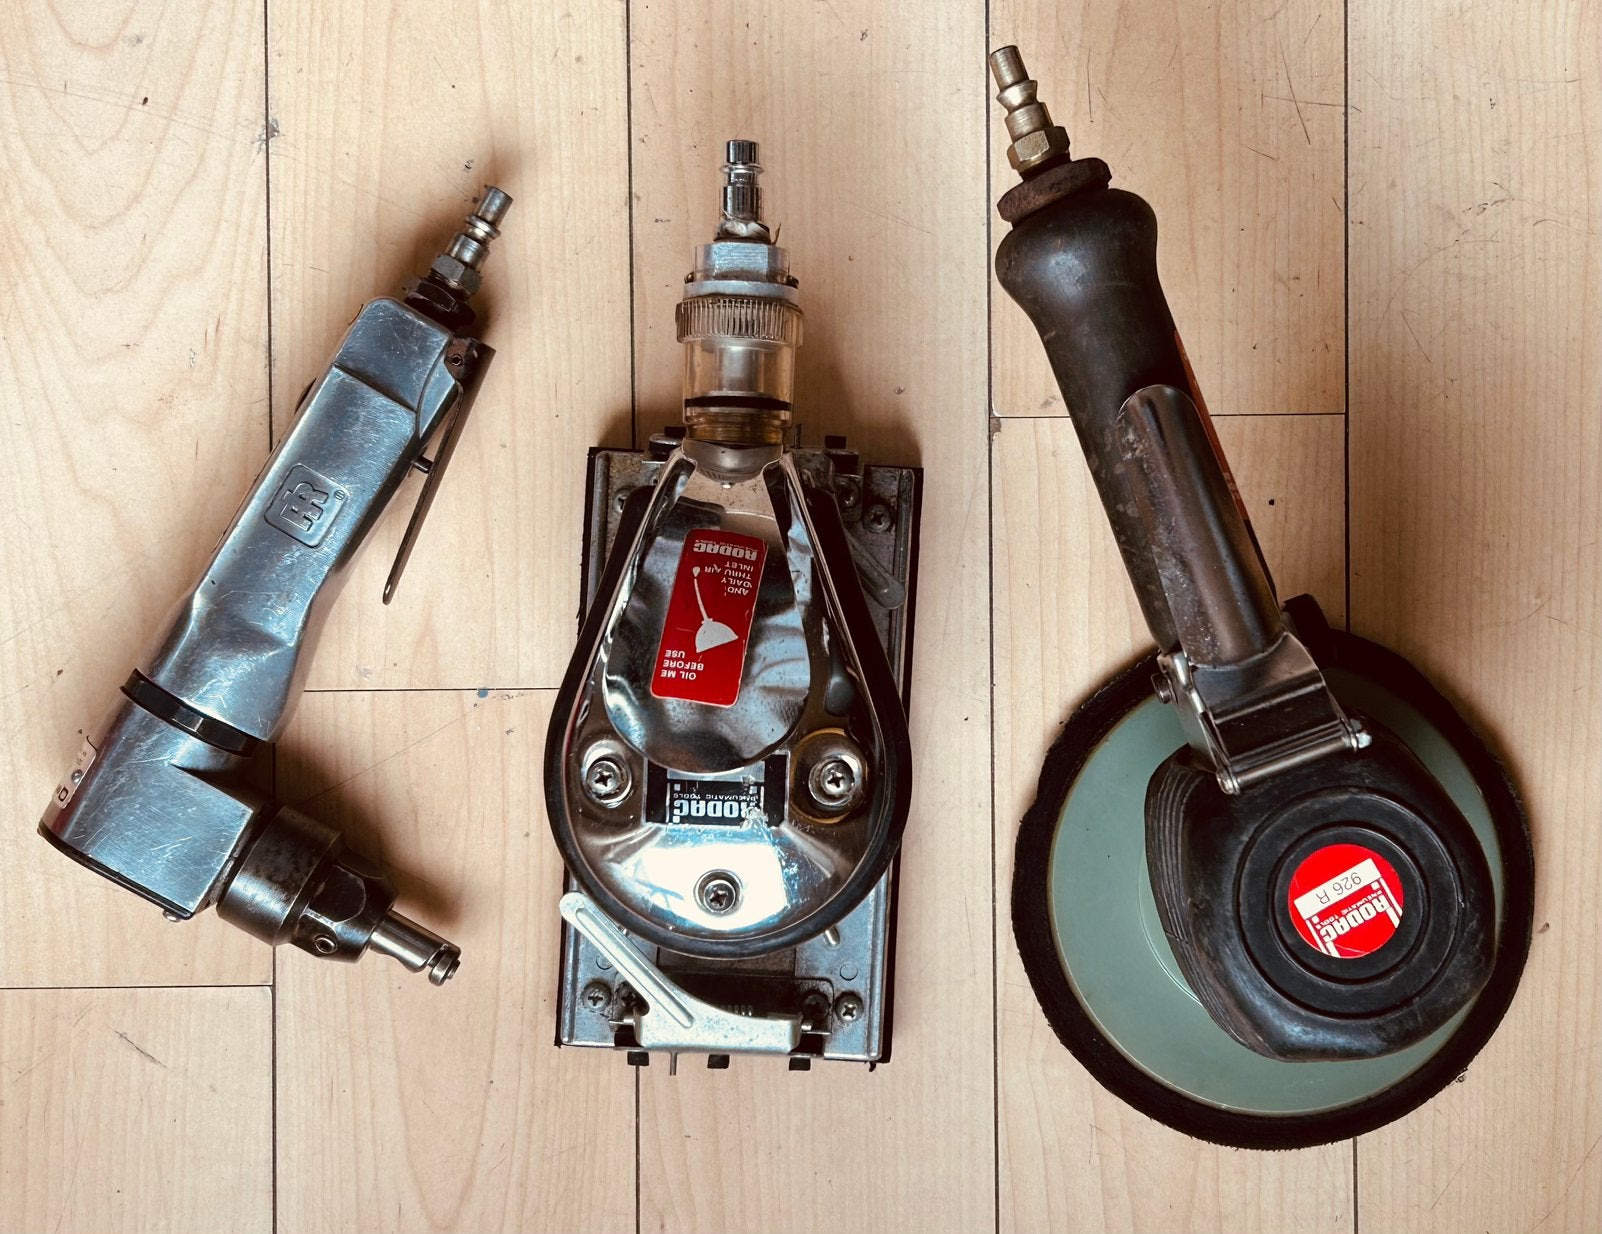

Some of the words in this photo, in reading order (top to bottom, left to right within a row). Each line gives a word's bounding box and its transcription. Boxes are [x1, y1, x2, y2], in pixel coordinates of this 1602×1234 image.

[693, 542, 758, 561] RODAC
[704, 564, 722, 573] AIR
[724, 561, 754, 572] INLET
[724, 569, 752, 580] THRU
[721, 577, 753, 588] DAILY
[727, 586, 749, 596] AND
[664, 649, 686, 659] USE
[662, 659, 705, 671] BEFORE
[660, 669, 677, 679] ME
[679, 670, 697, 680] OIL
[1332, 872, 1362, 896] 926
[1315, 889, 1331, 905] R
[1319, 894, 1391, 943] RODAC
